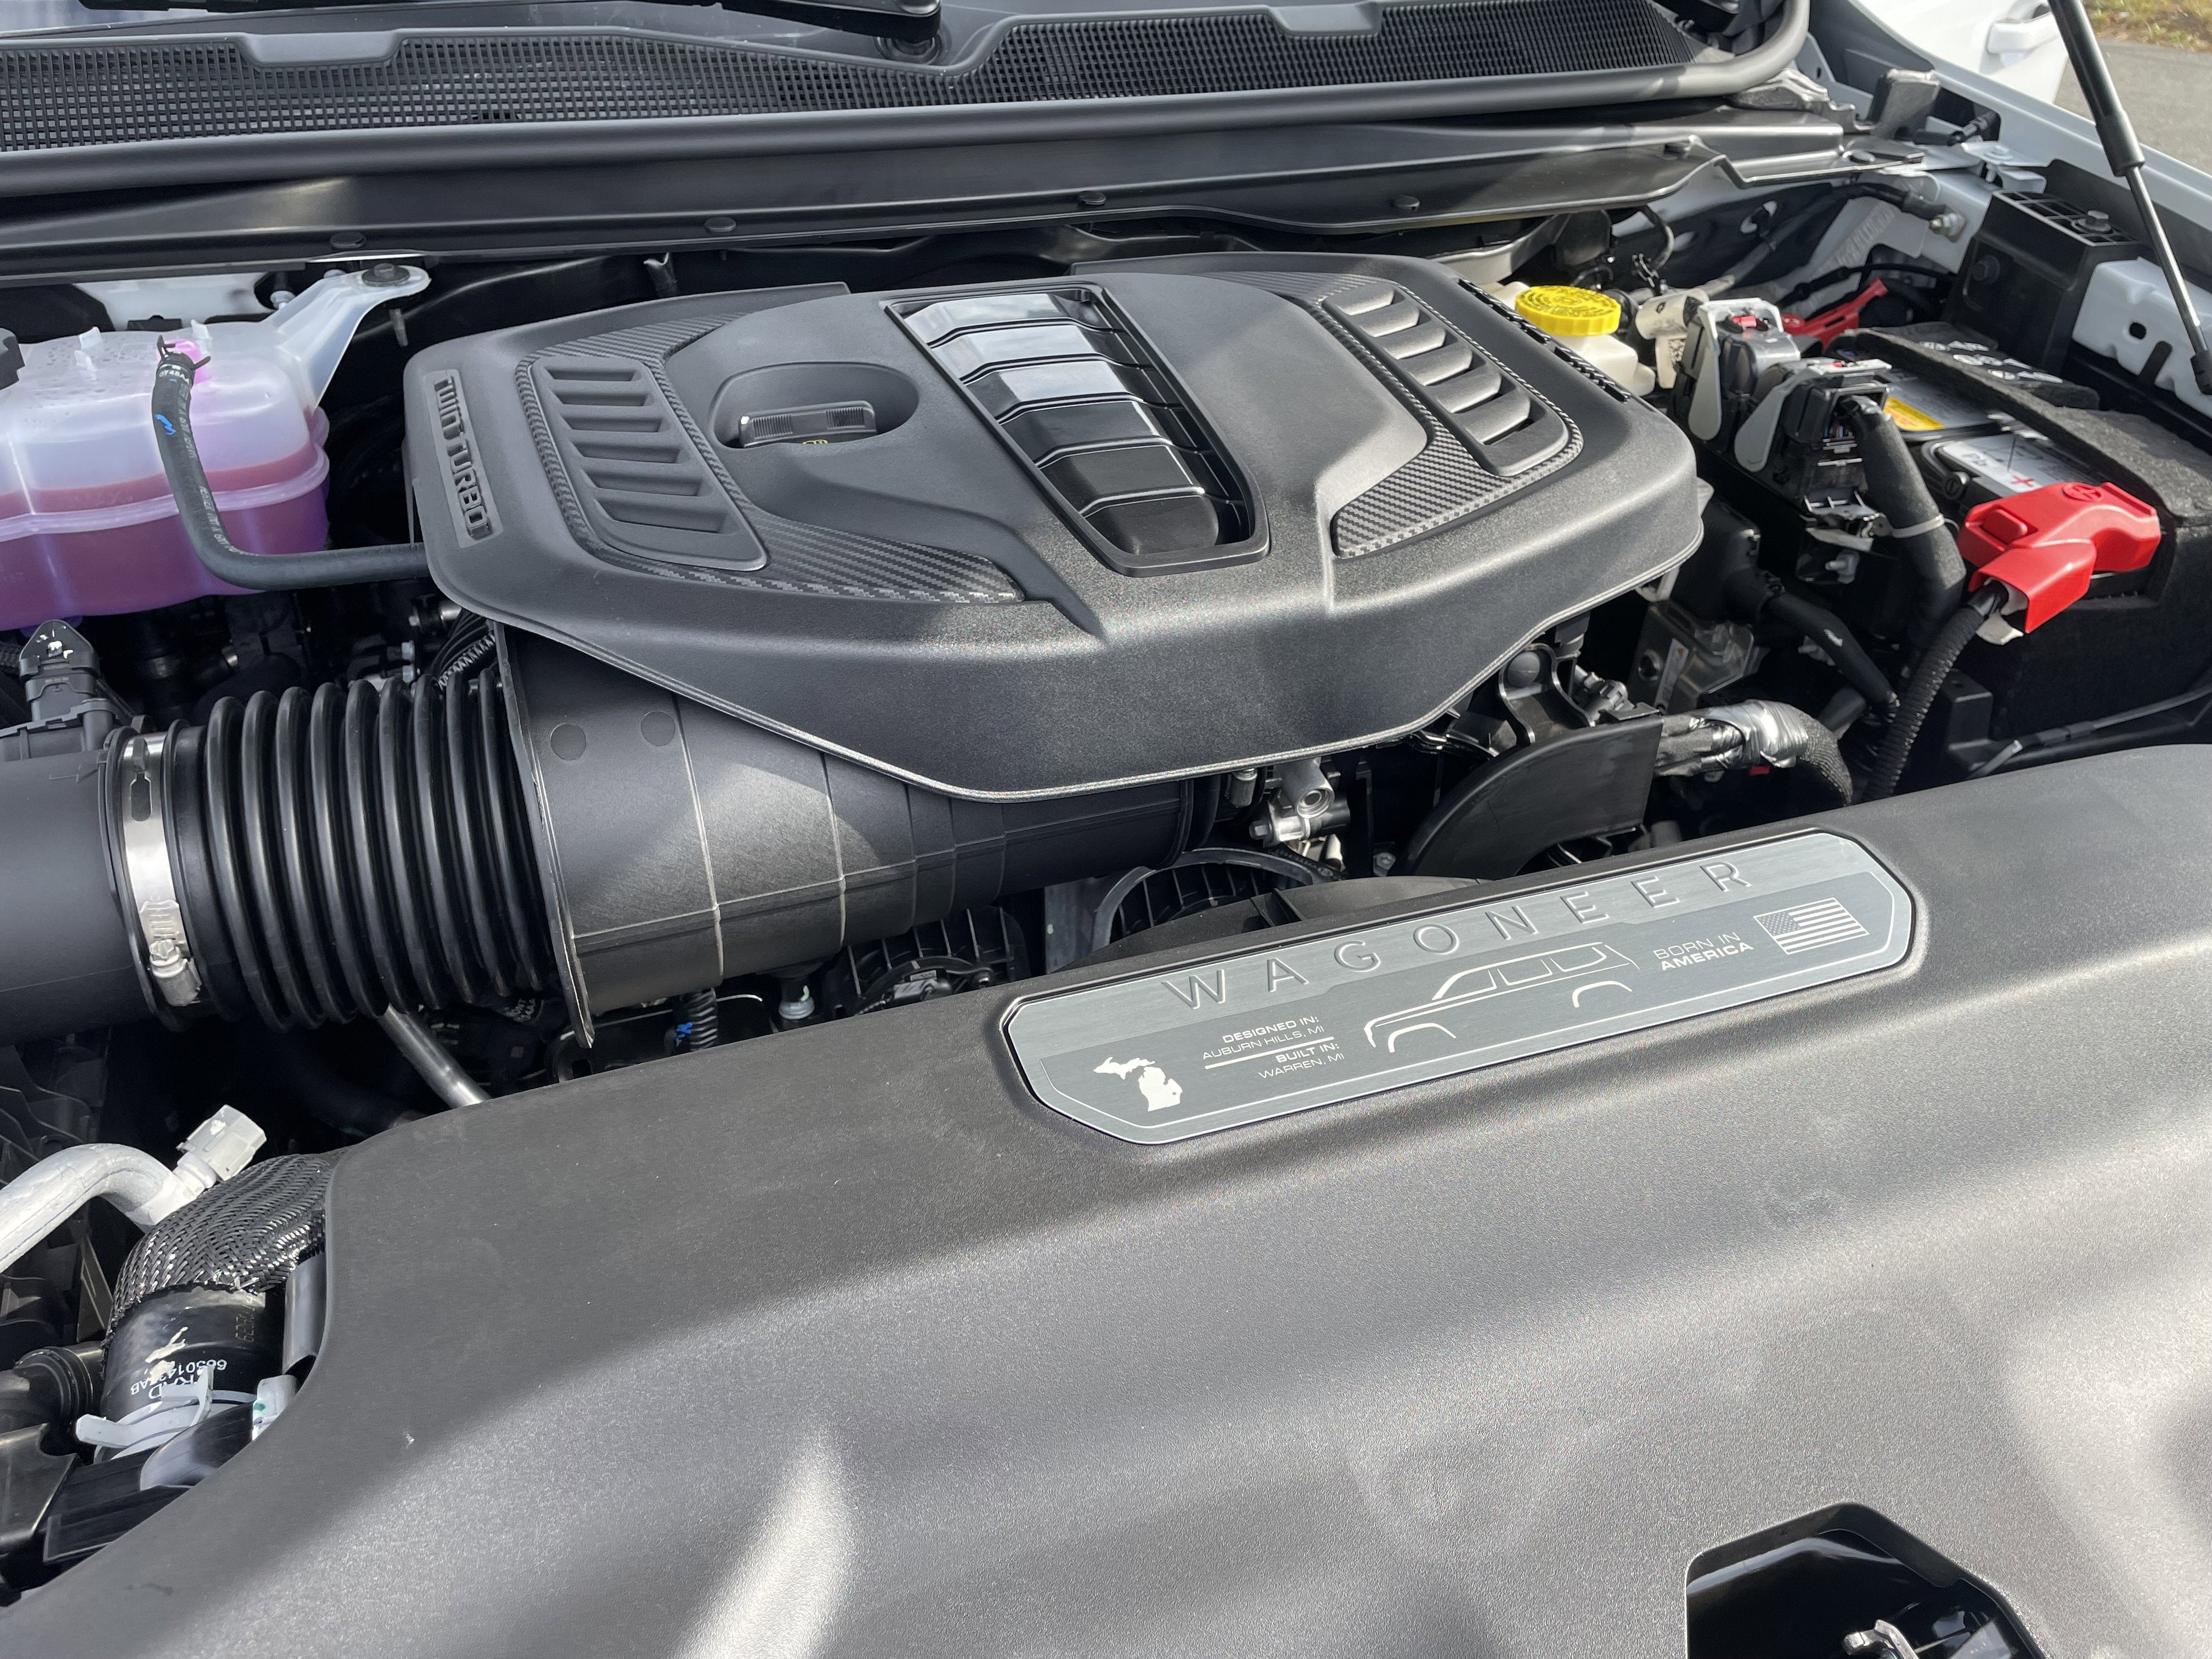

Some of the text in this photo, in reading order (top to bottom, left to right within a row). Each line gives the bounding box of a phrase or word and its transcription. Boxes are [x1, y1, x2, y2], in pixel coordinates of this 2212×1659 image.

[433, 375, 488, 528] TWIN TURBO
[1161, 862, 1752, 1009] WAGONEER
[1653, 932, 1741, 959] BORN IN
[1661, 942, 1754, 970] AMERICA
[1203, 1025, 1324, 1059] AUBURN HILLS, MI
[1222, 1016, 1319, 1043] DESIGNED IN:
[1258, 1053, 1345, 1079] WARREN, MI
[1276, 1042, 1340, 1063] BUILT IN:
